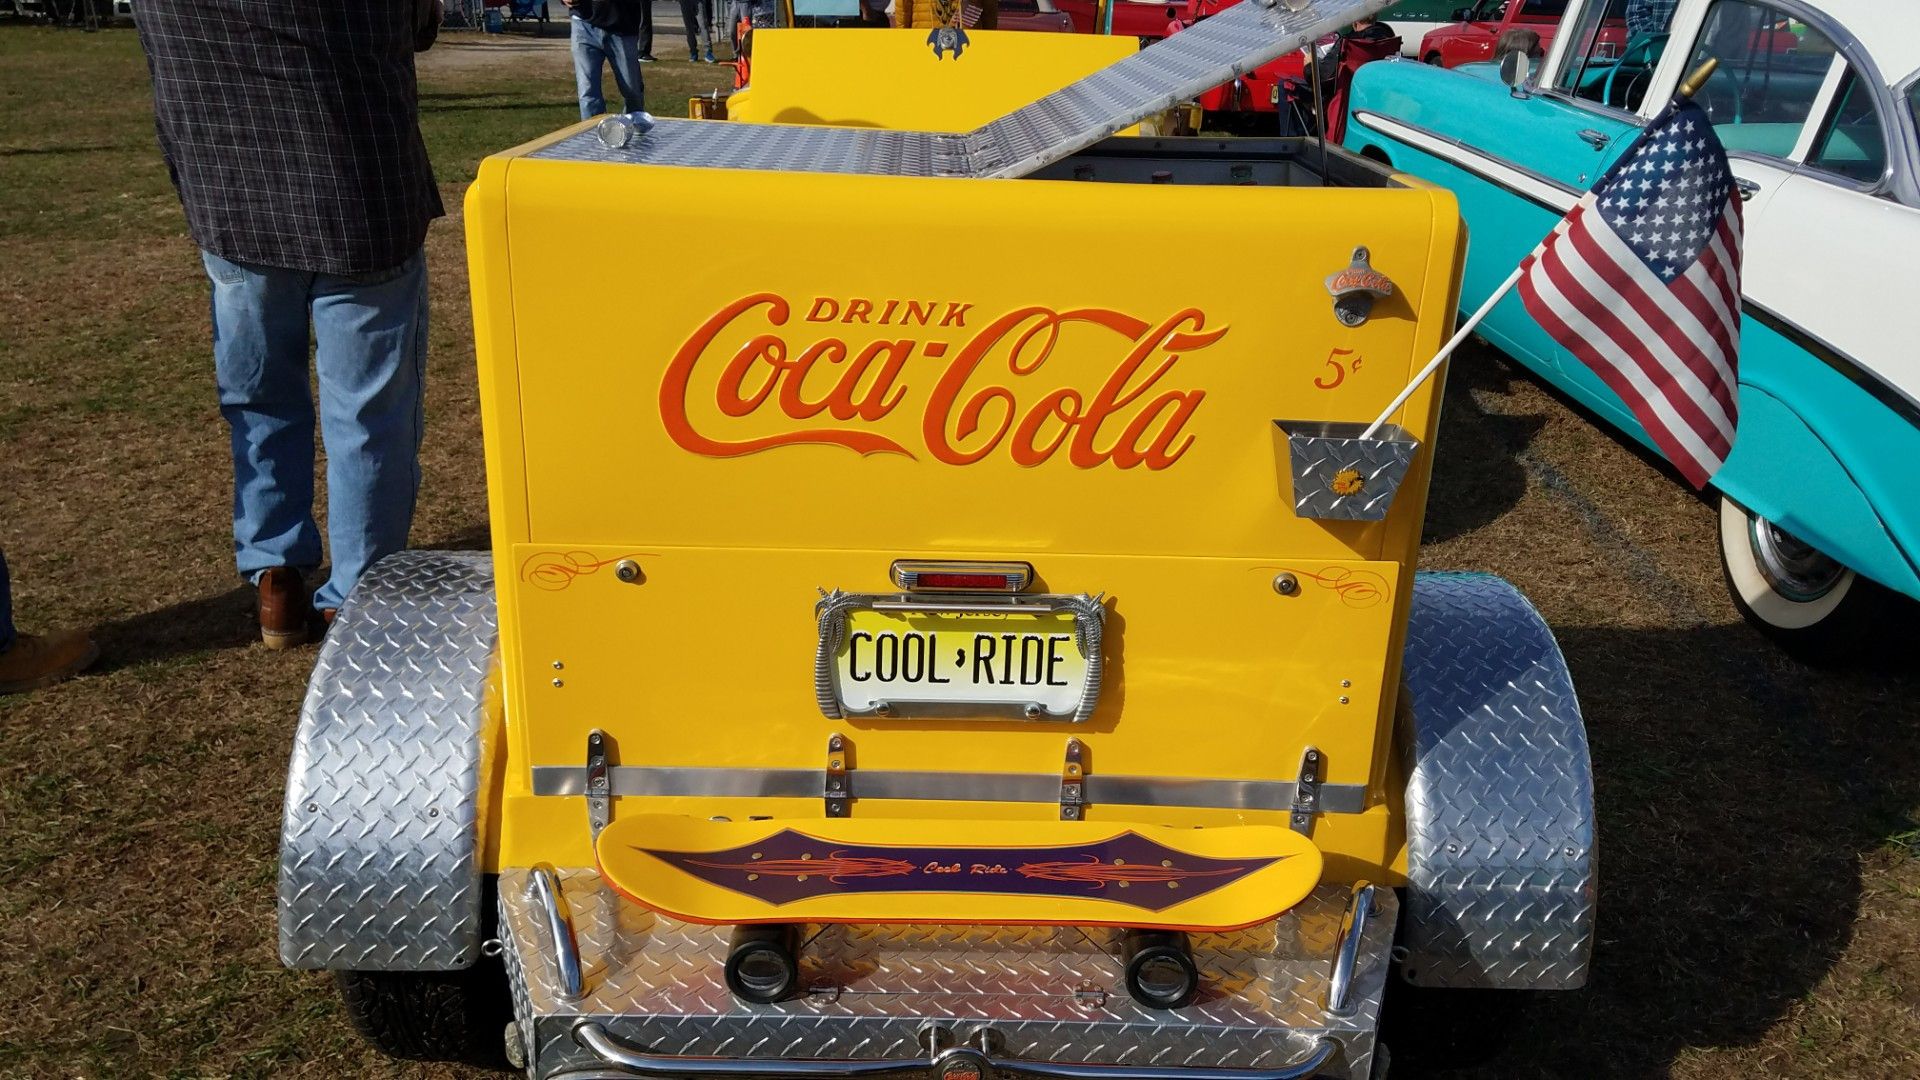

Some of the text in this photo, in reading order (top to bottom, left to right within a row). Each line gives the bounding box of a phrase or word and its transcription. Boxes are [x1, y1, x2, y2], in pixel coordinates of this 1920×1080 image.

[805, 297, 974, 327] DRINK
[659, 292, 1230, 471] Coca-Cola
[850, 632, 1071, 686] COOL RIDE
[923, 861, 1008, 875] Cool Ride
